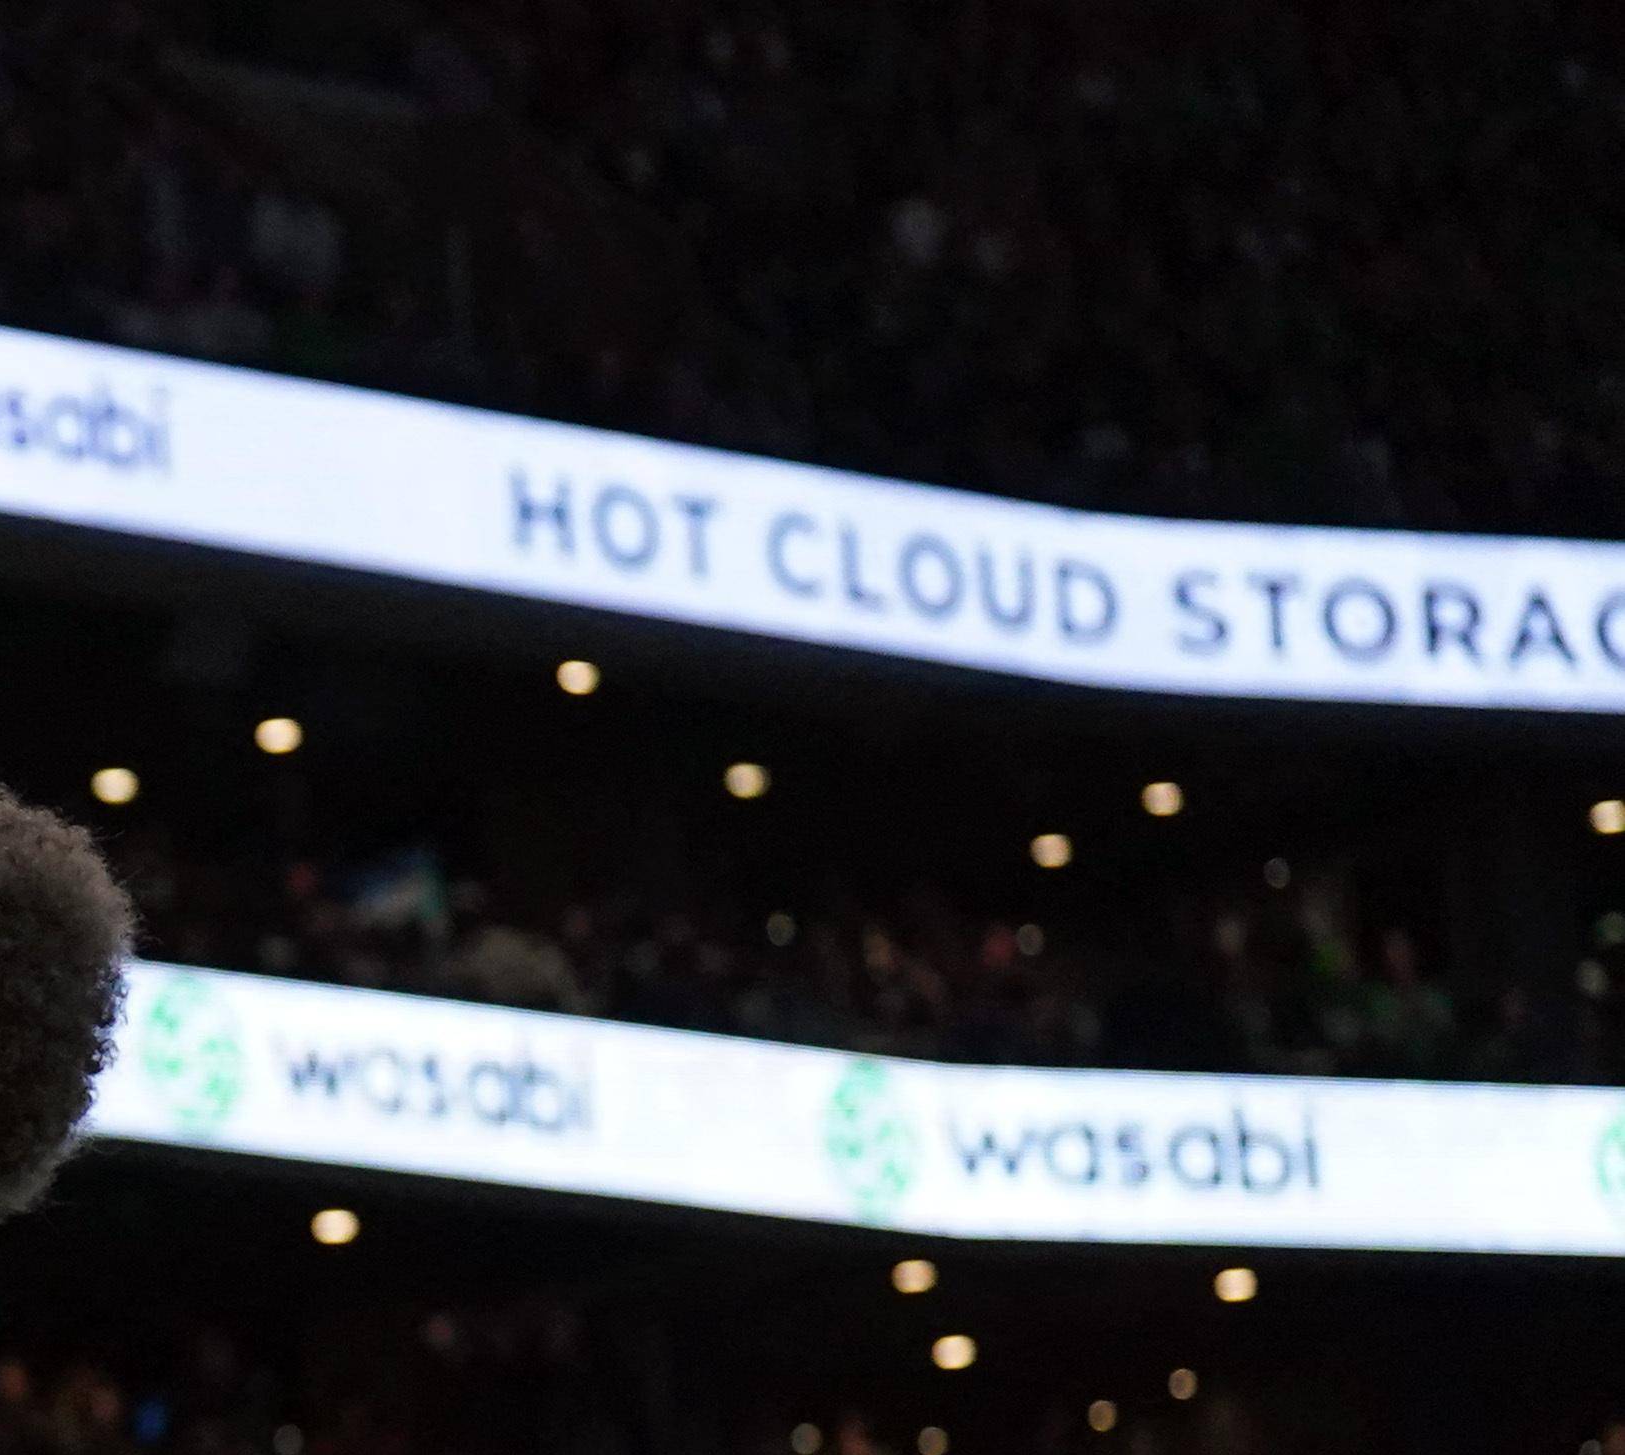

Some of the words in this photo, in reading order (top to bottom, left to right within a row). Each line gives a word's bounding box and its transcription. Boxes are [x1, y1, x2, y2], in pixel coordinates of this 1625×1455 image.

[506, 464, 725, 580] HOT
[765, 508, 1125, 649] CLOUD
[265, 1020, 599, 1142] wasabi
[951, 1086, 1323, 1196] wasabi
